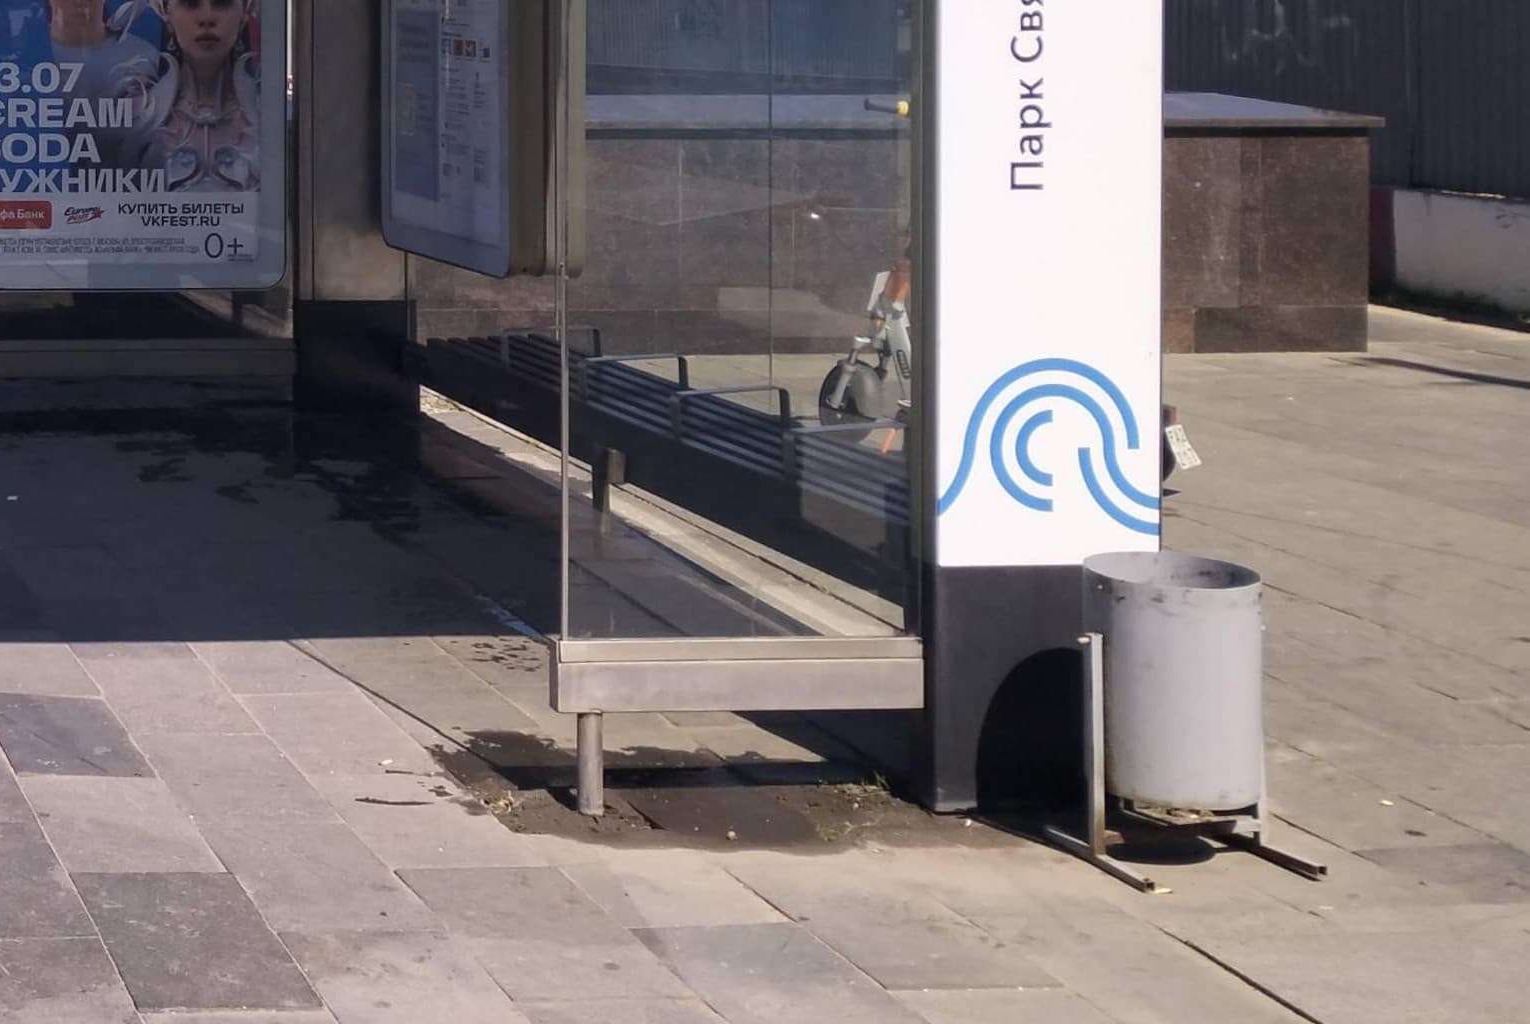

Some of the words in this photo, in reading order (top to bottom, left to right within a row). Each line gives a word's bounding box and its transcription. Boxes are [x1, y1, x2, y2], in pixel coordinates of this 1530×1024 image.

[1010, 77, 1053, 191] Парк
[118, 203, 179, 215] КУПИТЬ
[181, 203, 245, 215] БИЛЕТЫ
[141, 215, 221, 227] VKFEST.RU
[203, 232, 244, 259] 0+
